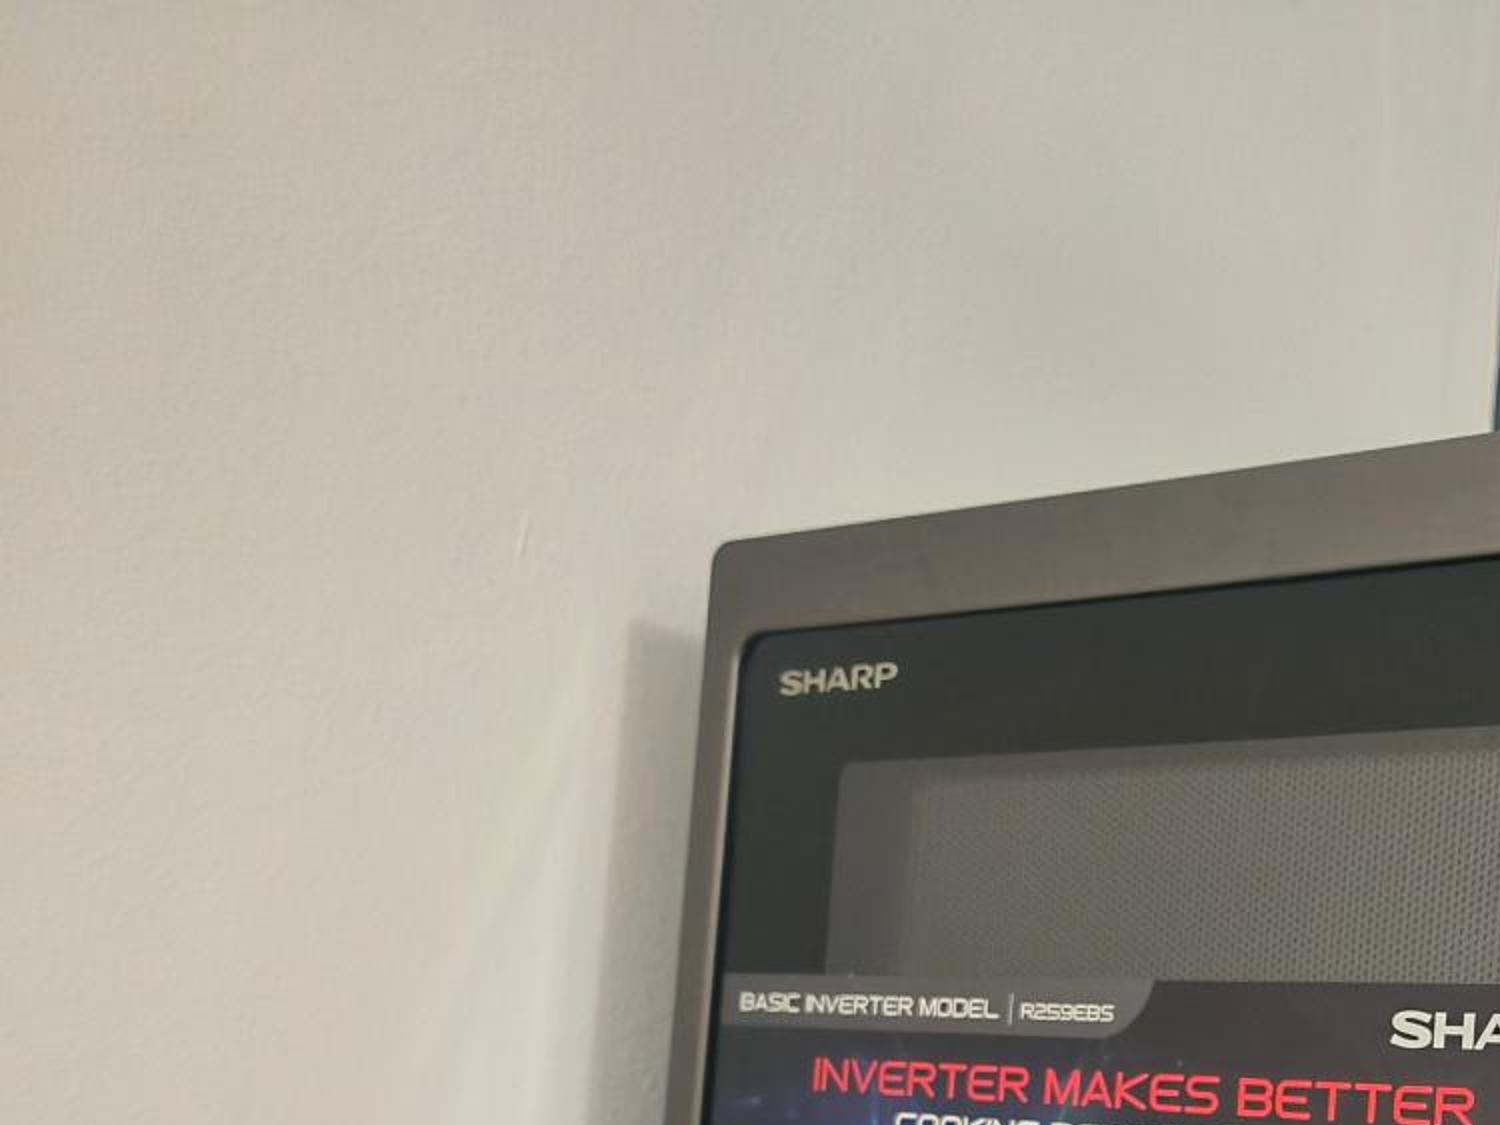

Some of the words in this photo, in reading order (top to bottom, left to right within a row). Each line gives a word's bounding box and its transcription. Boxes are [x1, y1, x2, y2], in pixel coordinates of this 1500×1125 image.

[778, 660, 899, 697] SHARP
[738, 991, 801, 1014] BASIC
[804, 993, 915, 1017] INVERTER
[917, 997, 1000, 1021] MODEL
[811, 1056, 1029, 1103] INVERTER
[1042, 1068, 1221, 1116] MAKES
